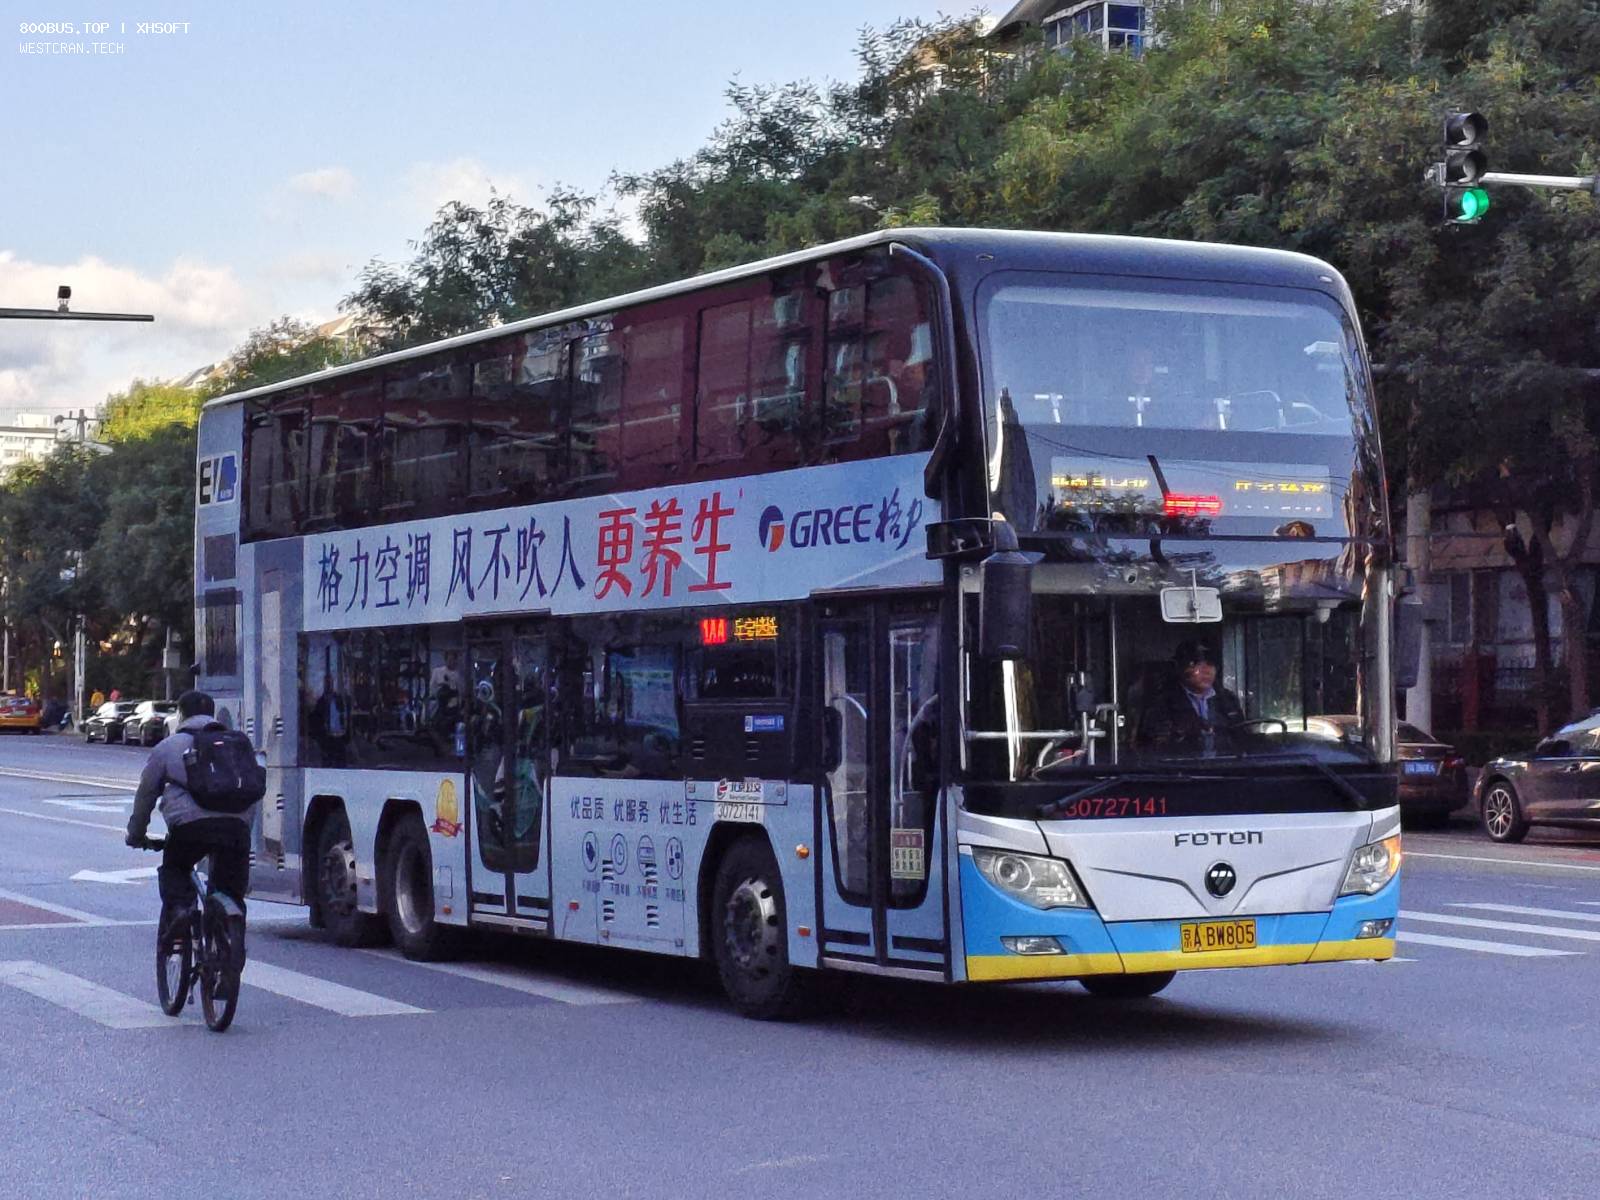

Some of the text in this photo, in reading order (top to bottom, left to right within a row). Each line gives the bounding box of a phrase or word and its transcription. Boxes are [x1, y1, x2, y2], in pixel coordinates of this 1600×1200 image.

[790, 503, 873, 548] GREE
[317, 491, 735, 613] 格力空调 风不吹人 更养生
[570, 796, 697, 826] 优品质 优服务 优生活
[717, 803, 759, 820] 30727141
[1065, 796, 1167, 818] 30727141
